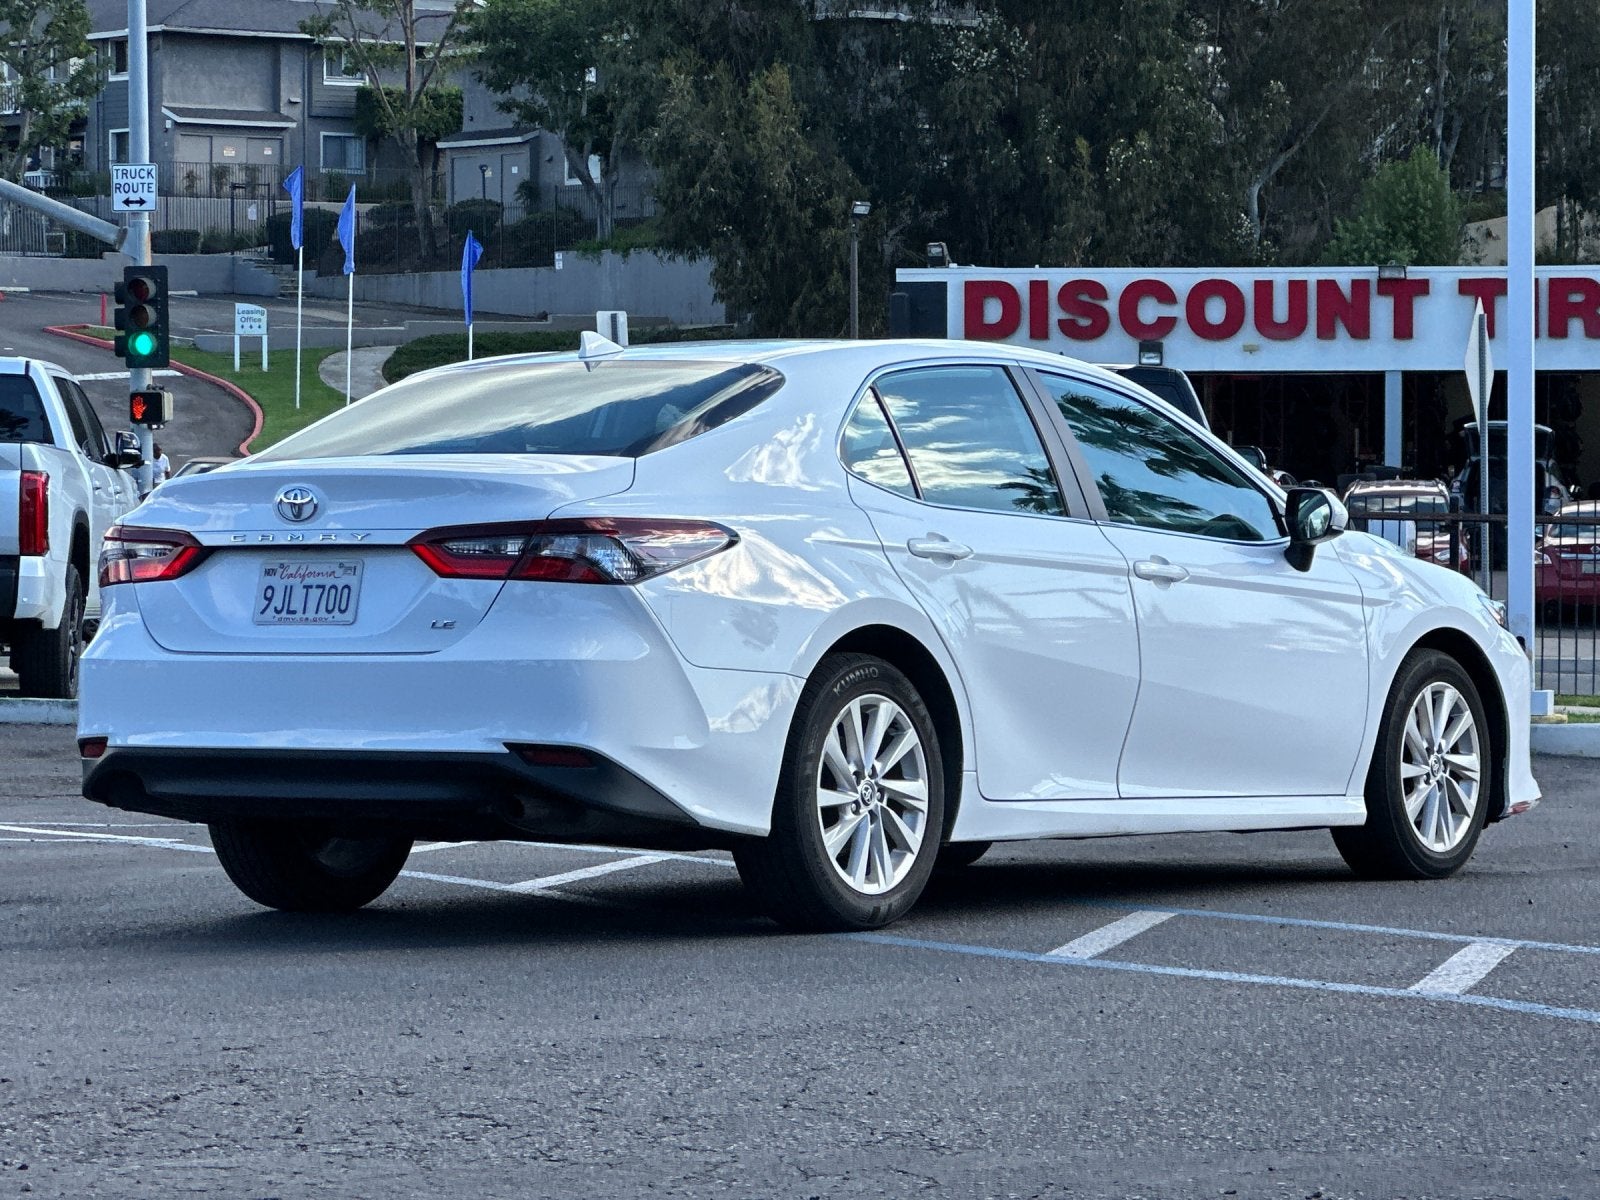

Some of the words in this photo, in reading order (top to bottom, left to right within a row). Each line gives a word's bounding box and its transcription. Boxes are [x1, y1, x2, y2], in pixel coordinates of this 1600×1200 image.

[114, 168, 155, 180] TRUCK
[114, 182, 154, 194] ROUTE
[237, 308, 265, 316] Leasing
[964, 278, 1430, 341] DISCOUNT
[1458, 277, 1600, 339] TR
[230, 533, 371, 542] CAMRY
[280, 563, 341, 584] California
[259, 584, 352, 615] 9JLT700
[430, 619, 457, 630] LE
[832, 666, 879, 696] KUMHO
